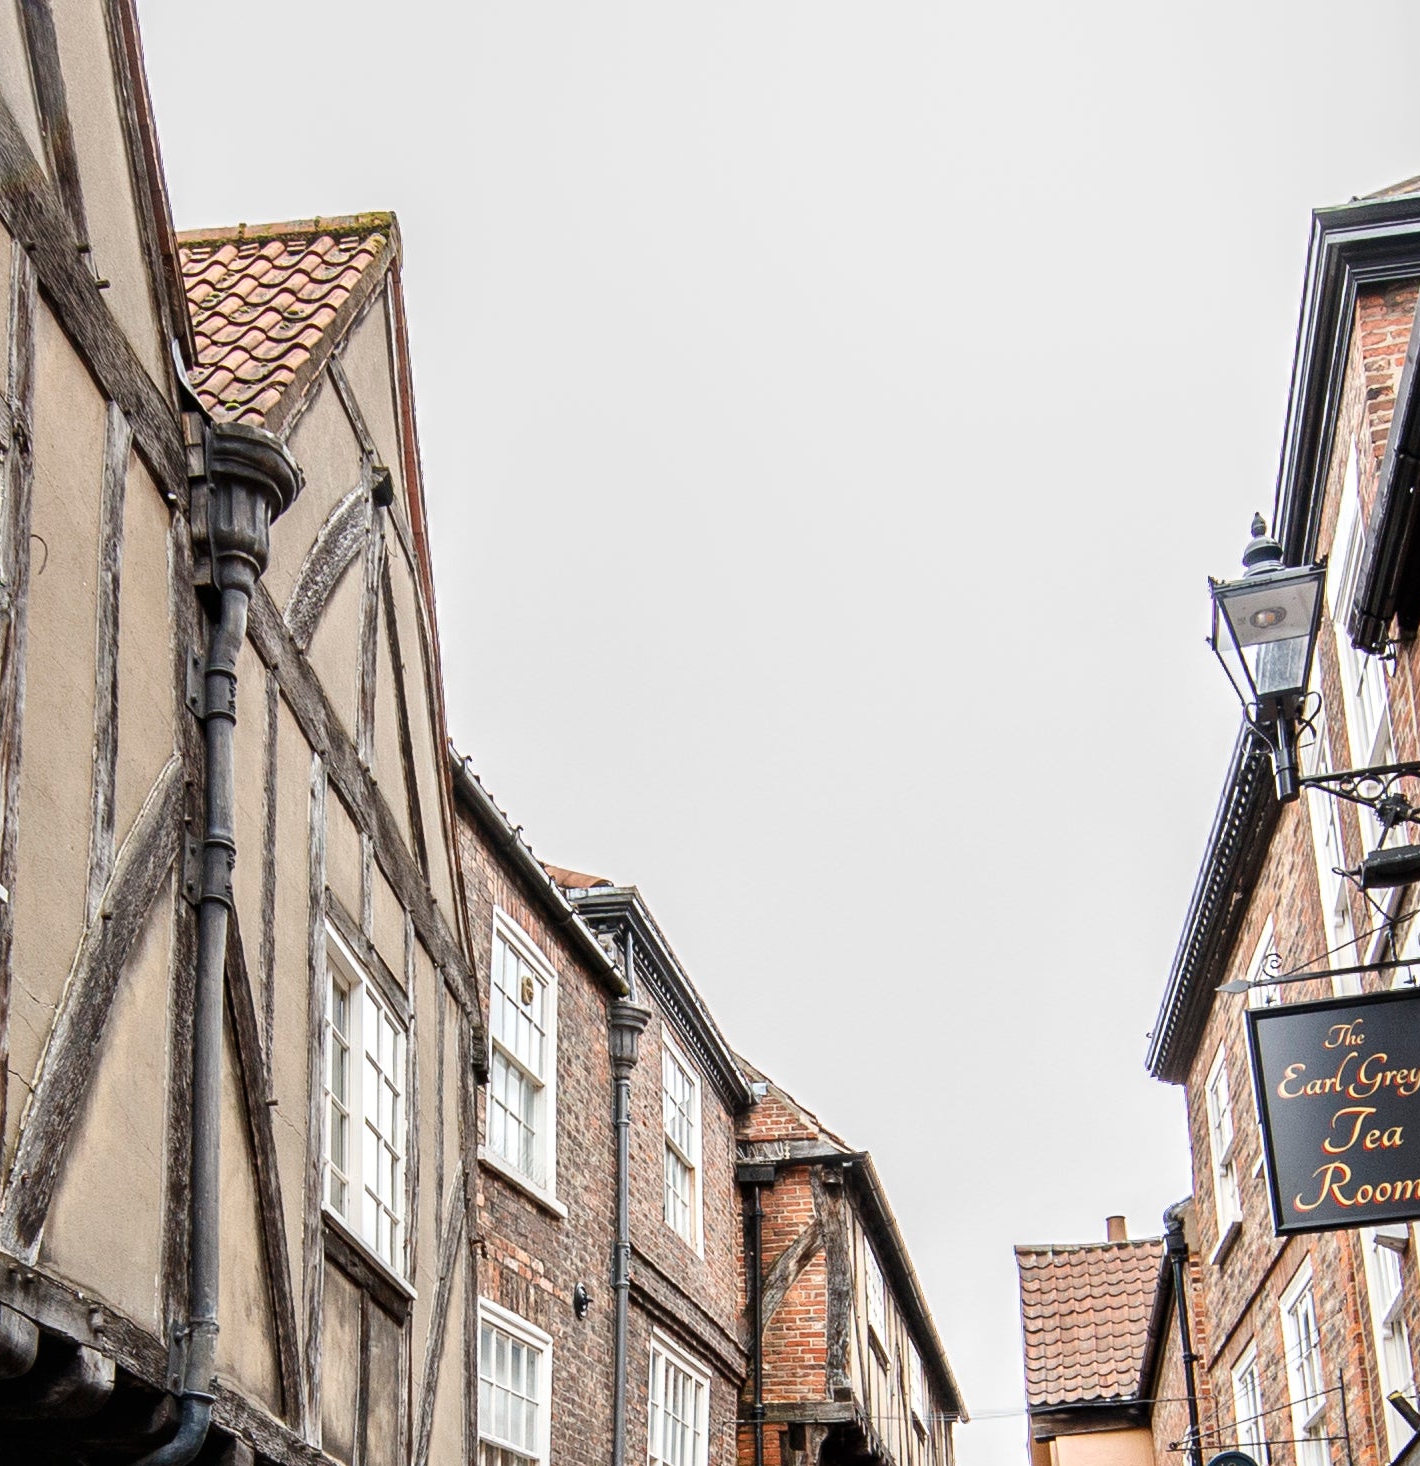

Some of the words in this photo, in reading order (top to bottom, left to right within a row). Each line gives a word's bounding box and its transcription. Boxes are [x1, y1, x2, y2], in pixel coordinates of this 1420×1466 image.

[1323, 1018, 1366, 1049] The
[1277, 1051, 1358, 1099] Earl
[1322, 1107, 1404, 1154] Tea
